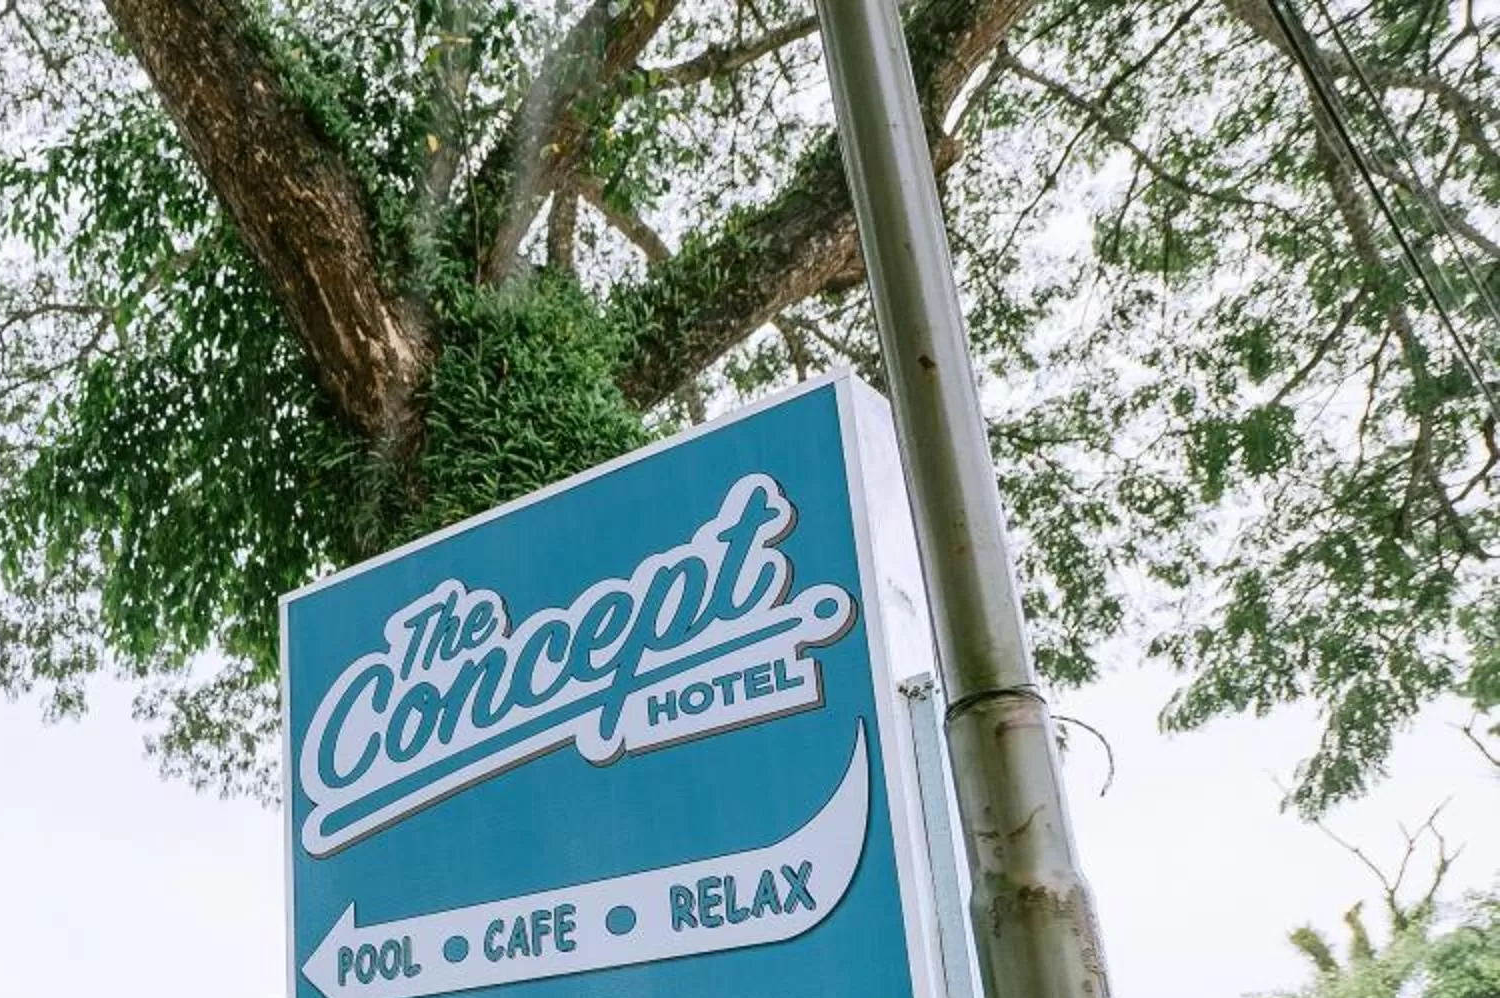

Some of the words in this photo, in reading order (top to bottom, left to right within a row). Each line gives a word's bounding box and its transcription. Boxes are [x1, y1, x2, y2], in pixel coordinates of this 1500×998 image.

[314, 482, 788, 790] Concept
[400, 592, 500, 681] The
[647, 660, 805, 727] HOTEL
[336, 935, 423, 986] POOL
[482, 903, 578, 963] CAFE
[669, 858, 817, 932] RELAX
